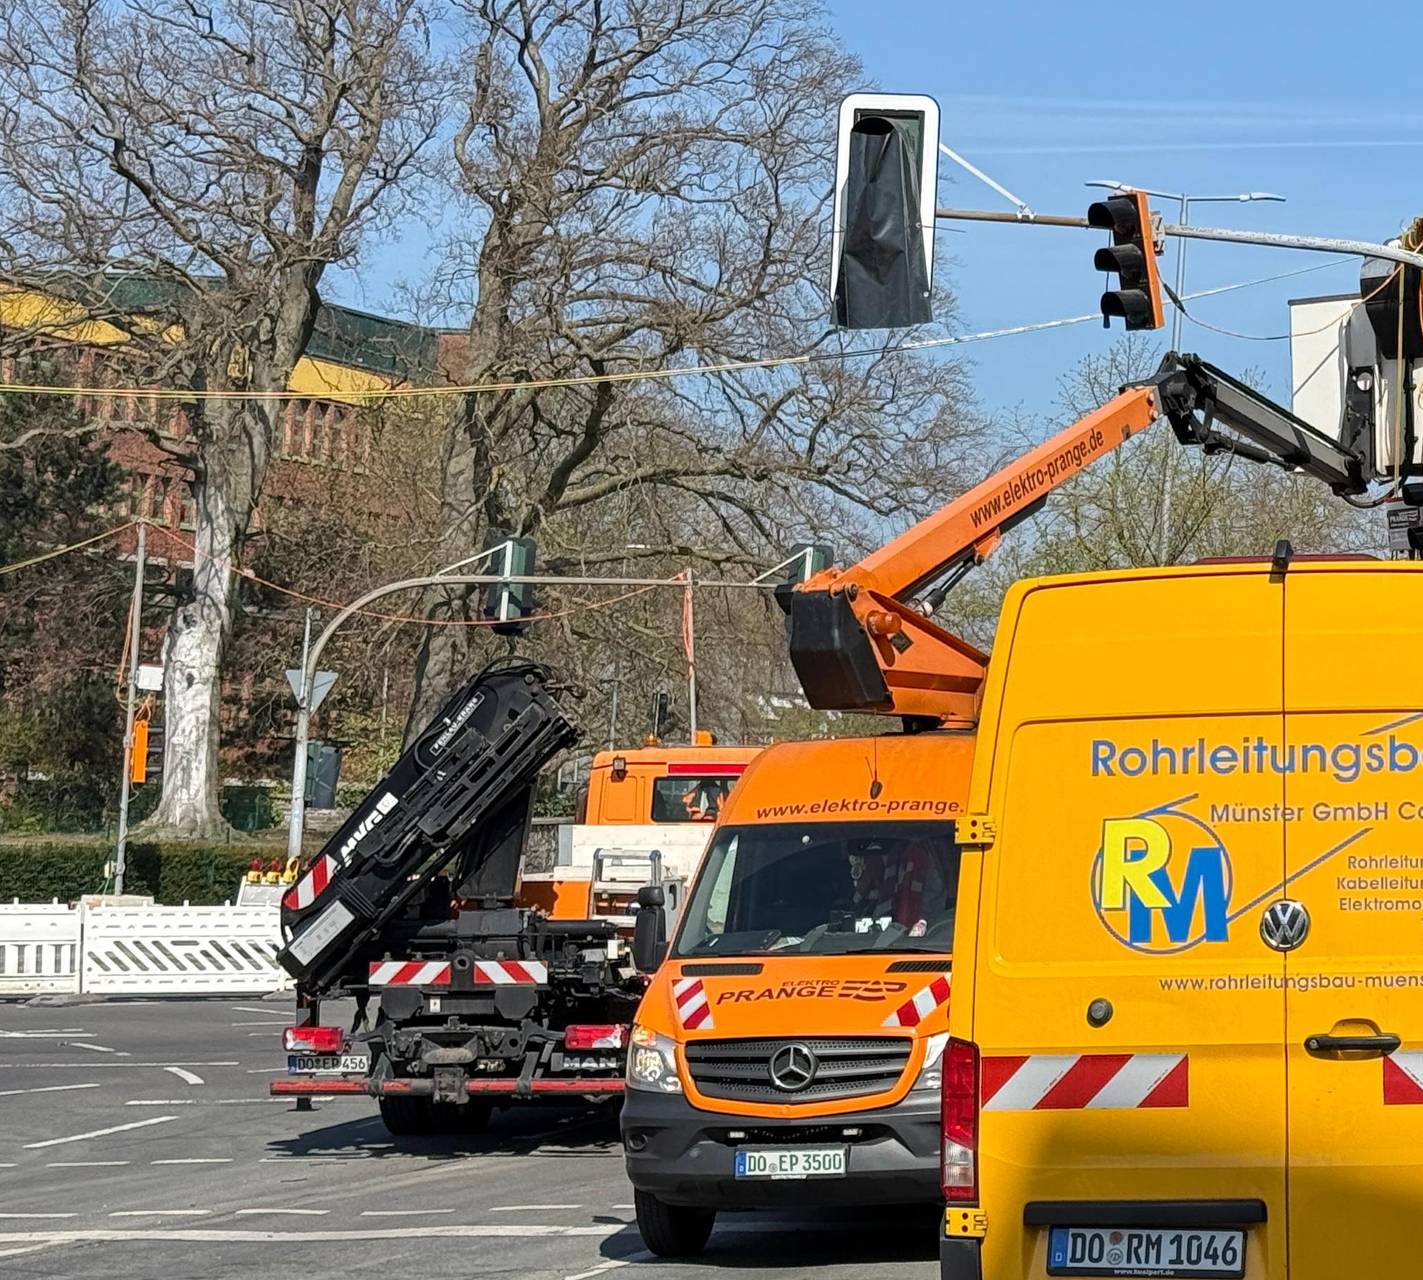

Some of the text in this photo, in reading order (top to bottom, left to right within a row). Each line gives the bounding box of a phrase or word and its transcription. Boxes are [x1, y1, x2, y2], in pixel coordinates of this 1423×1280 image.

[970, 428, 1104, 528] www.elektro-prange.de
[1210, 802, 1304, 823] Münster
[1312, 801, 1389, 822] GmbH
[782, 979, 840, 987] ELEKTRO
[716, 986, 835, 1005] PRANGE
[298, 1057, 314, 1070] DO
[342, 1057, 366, 1070] 456
[564, 1057, 617, 1069] MAN
[747, 1155, 767, 1172] DO
[778, 1154, 799, 1172] EP
[802, 1153, 842, 1171] 3500
[1069, 1232, 1105, 1263] DO
[1126, 1233, 1163, 1265] RM
[1168, 1234, 1238, 1266] 1046
